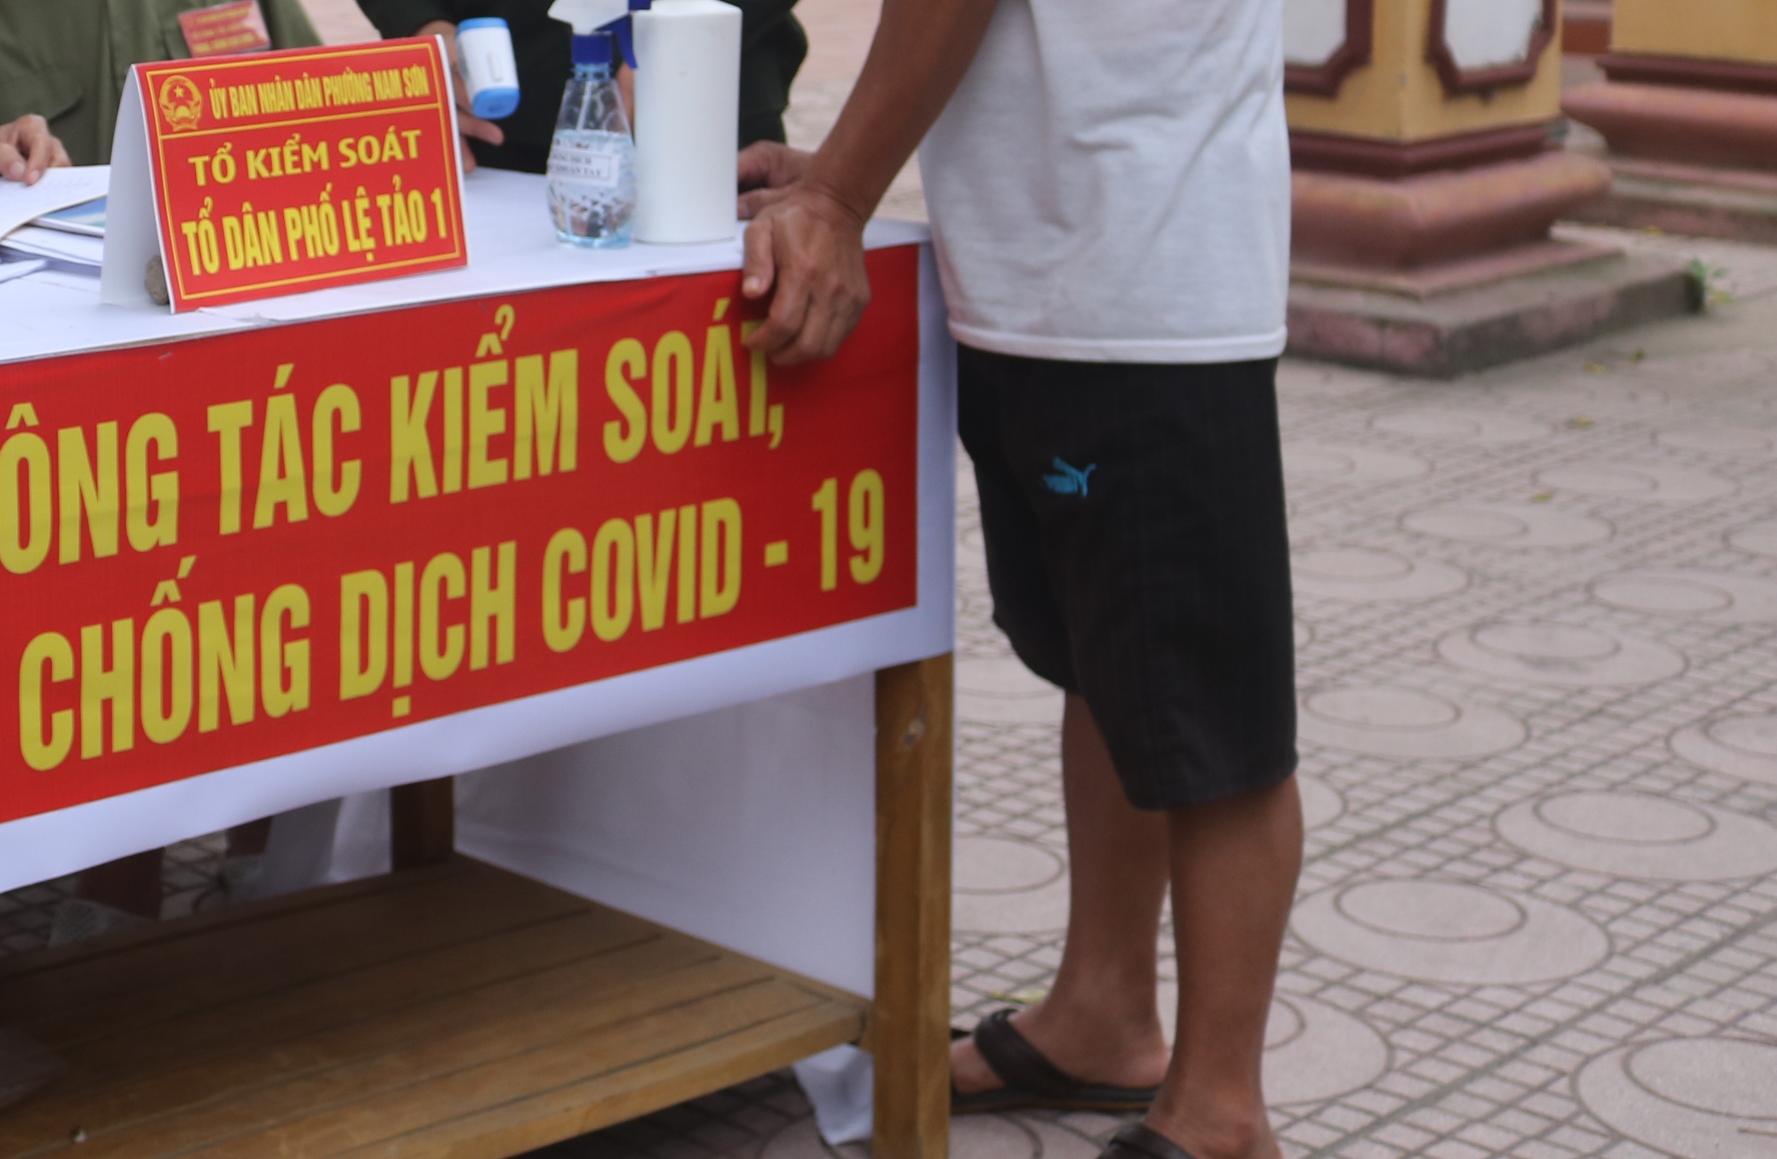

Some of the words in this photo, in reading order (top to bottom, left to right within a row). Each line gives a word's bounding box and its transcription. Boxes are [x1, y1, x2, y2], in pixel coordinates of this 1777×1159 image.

[208, 78, 229, 120] ỦY
[228, 84, 258, 118] BAN
[258, 75, 295, 114] NHÂN
[294, 72, 323, 110] DÂN
[323, 67, 373, 107] PHƯỜNG
[372, 68, 403, 101] NAM
[402, 64, 430, 98] SƠN
[187, 142, 237, 186] TỔ
[246, 133, 330, 180] KIỂM
[339, 125, 421, 169] SOÁT
[181, 197, 221, 276] TỔ
[222, 202, 283, 271] DÂN
[283, 183, 340, 262] PHỐ
[341, 186, 375, 262] LỆ
[376, 175, 427, 247] TẢO
[431, 188, 447, 239] 1
[207, 364, 361, 535] TÁC
[390, 304, 578, 503] KIỂM
[603, 298, 783, 463] SOÁT,
[19, 556, 310, 771] CHỐNG
[340, 541, 516, 717] DỊCH
[542, 498, 742, 653] COVID
[765, 541, 788, 567] -
[812, 470, 884, 590] 19
